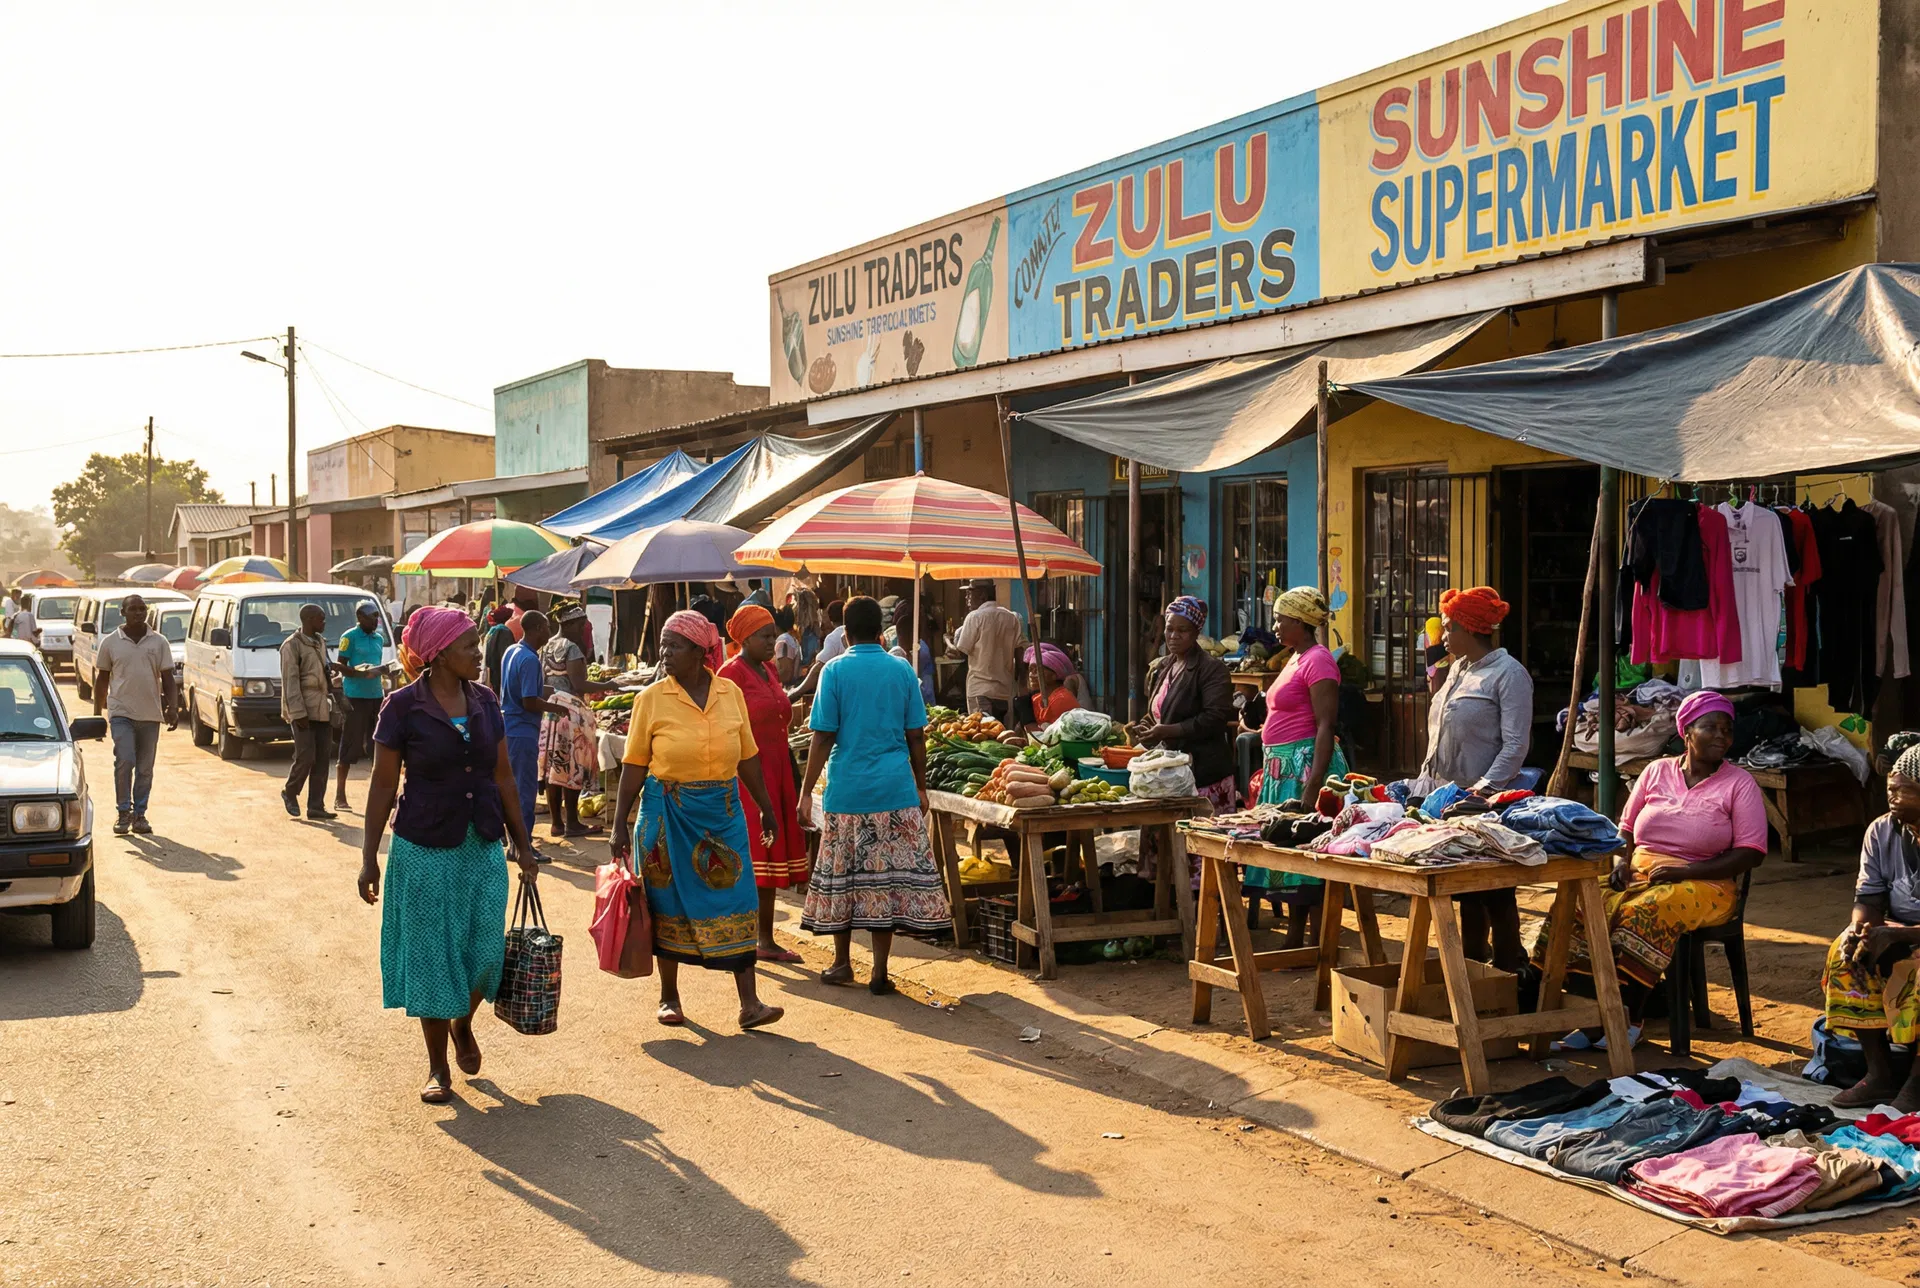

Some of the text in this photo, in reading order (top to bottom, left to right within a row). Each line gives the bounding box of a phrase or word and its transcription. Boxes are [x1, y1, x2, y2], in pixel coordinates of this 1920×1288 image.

[1370, 0, 1786, 174] SUNSHINE
[1073, 131, 1268, 271] ZULU
[1370, 75, 1785, 273] SUPERMARKET
[808, 232, 963, 325] ZULU TRADERS
[827, 320, 863, 346] SUNSHINE
[1054, 228, 1296, 342] TRADERS
